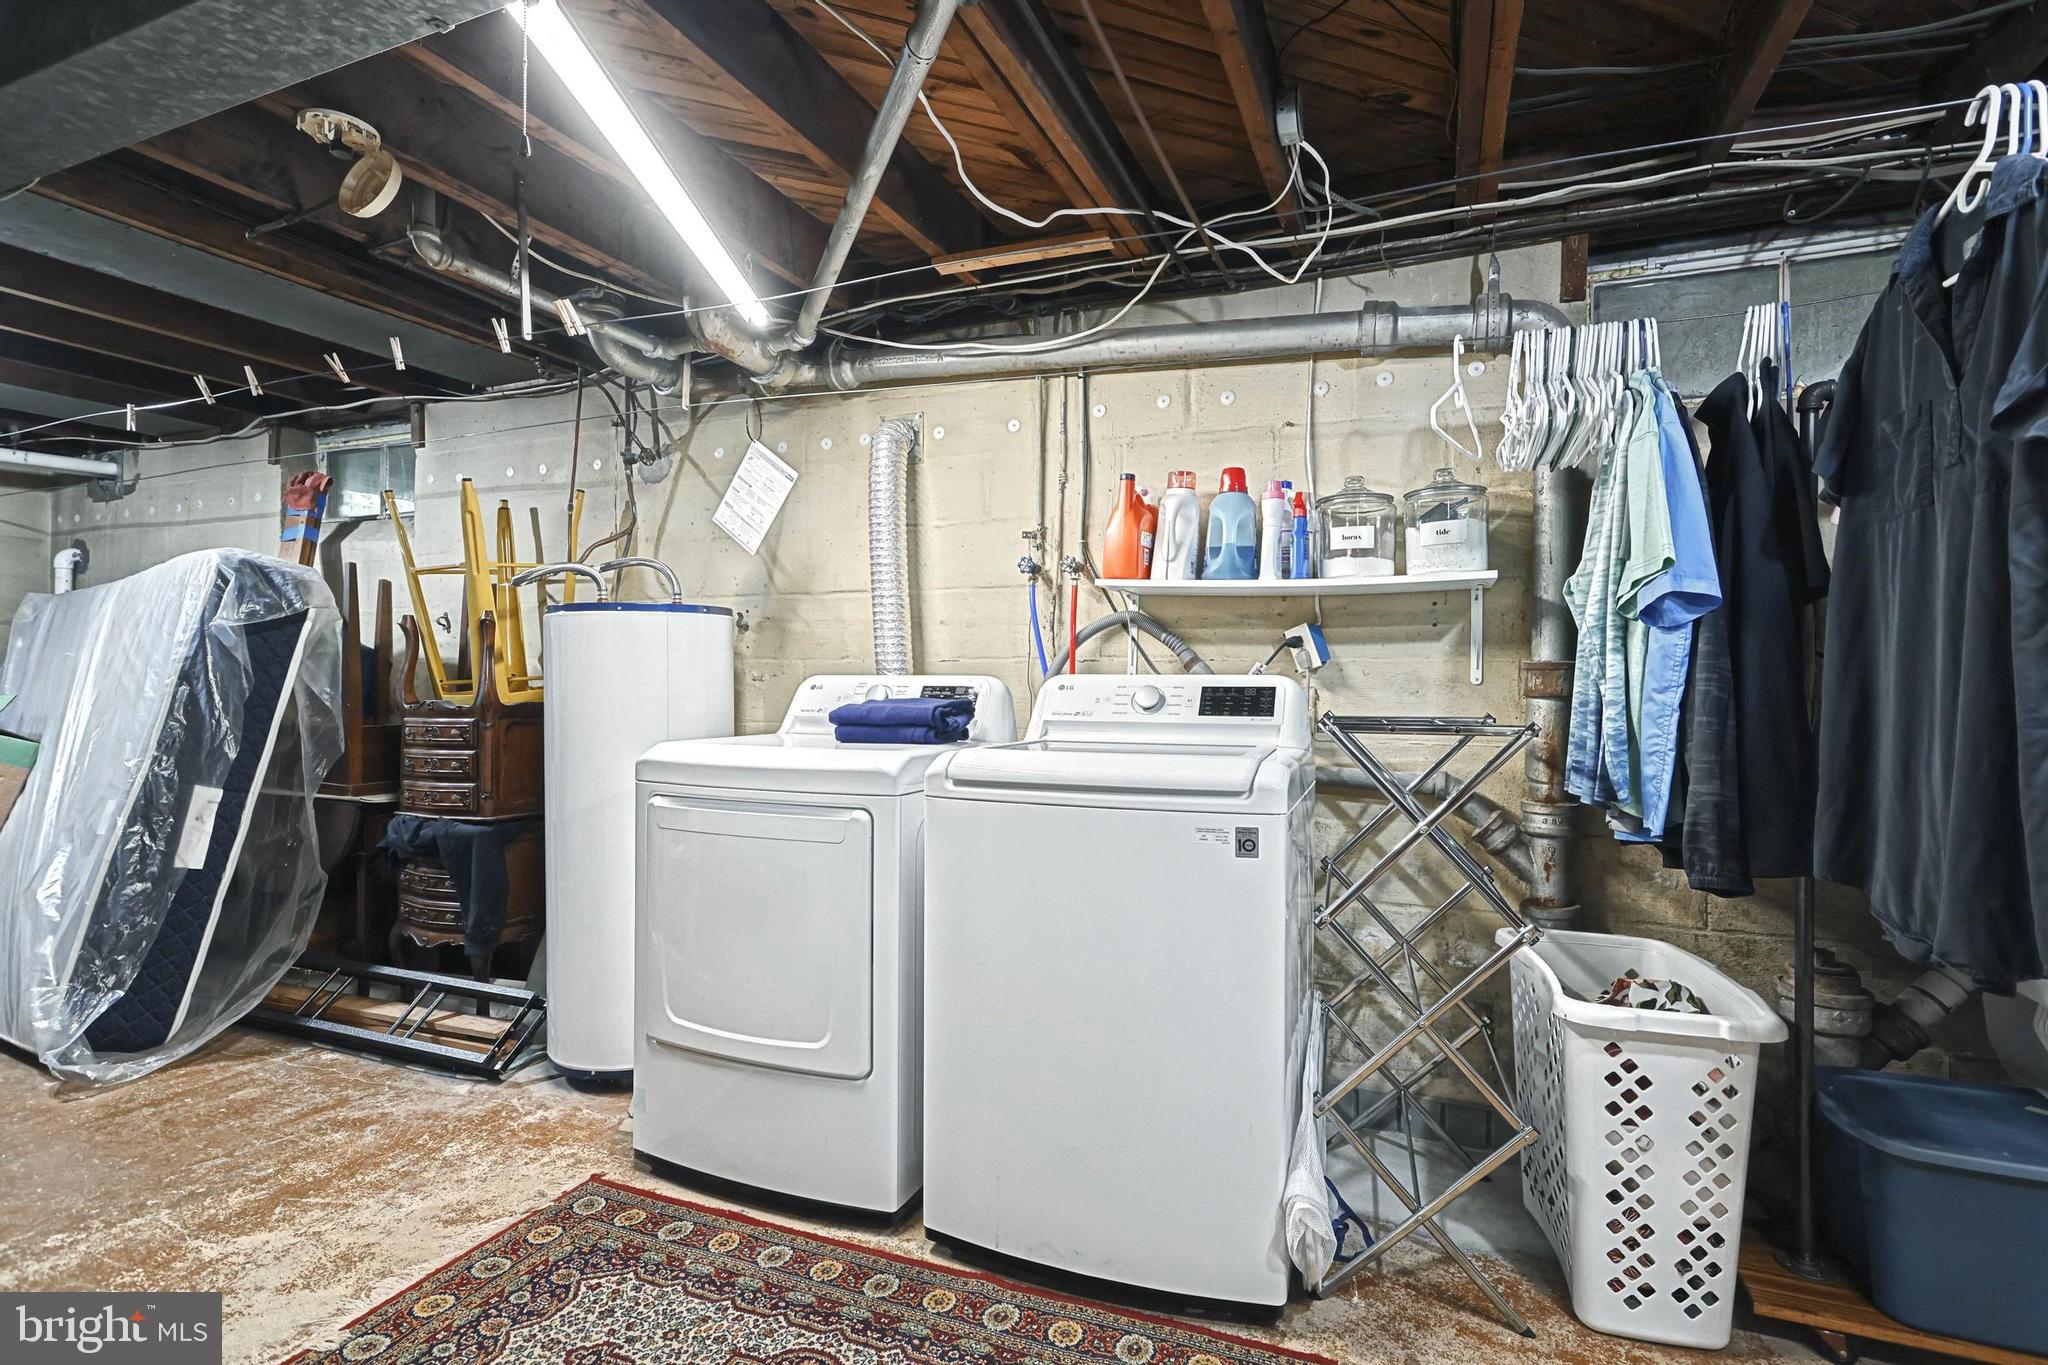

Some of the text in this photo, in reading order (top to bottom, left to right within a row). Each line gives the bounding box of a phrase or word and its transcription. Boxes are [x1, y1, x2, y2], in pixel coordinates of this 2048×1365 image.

[1435, 528, 1451, 536] tide
[1341, 533, 1362, 541] borax
[1237, 838, 1257, 852] 10
